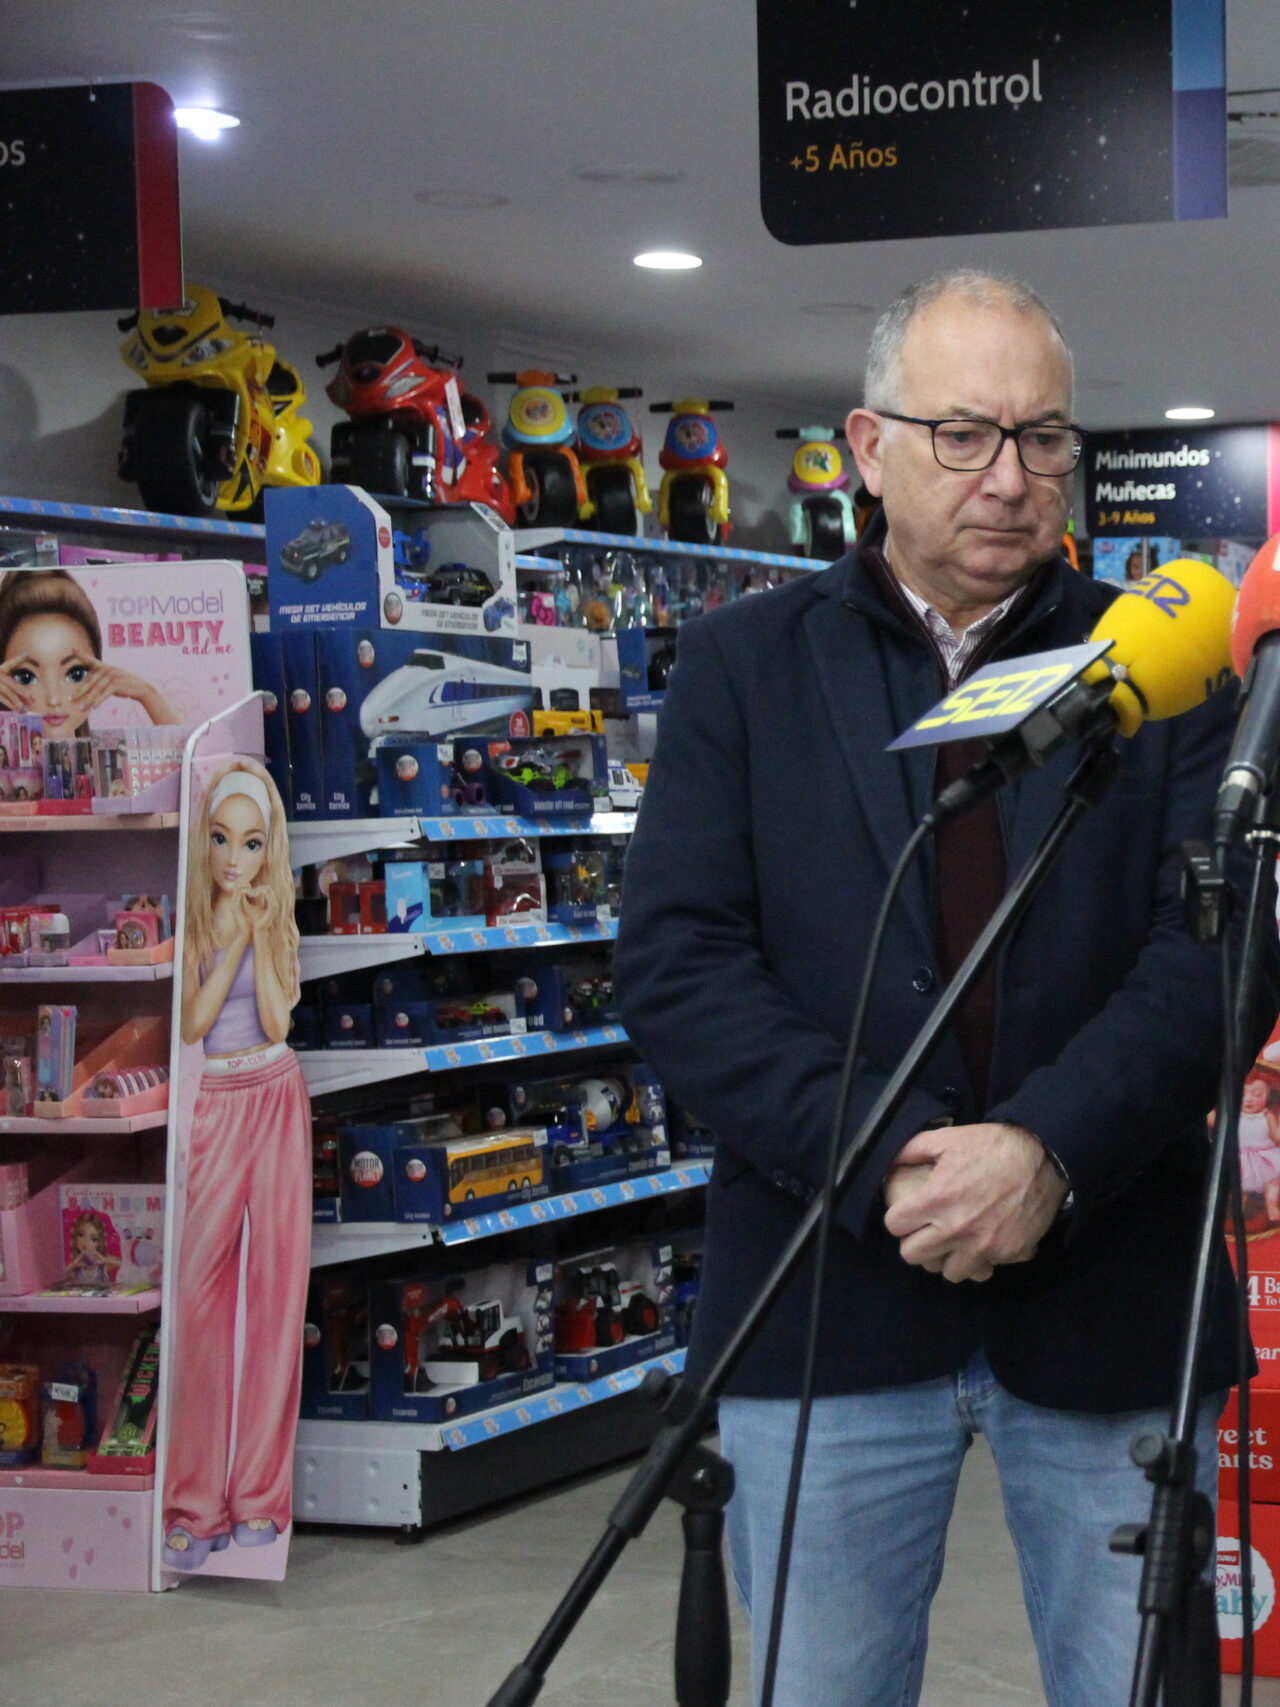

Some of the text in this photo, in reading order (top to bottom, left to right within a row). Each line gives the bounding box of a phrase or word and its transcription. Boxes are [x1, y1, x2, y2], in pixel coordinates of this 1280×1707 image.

[785, 58, 1043, 121] Radiocontrol
[790, 141, 898, 172] +5 Años
[1095, 444, 1211, 471] Minimundos
[1095, 480, 1177, 503] Muñecas
[1123, 509, 1156, 525] Años
[106, 590, 225, 616] TOPModel
[107, 620, 224, 648] BEAUTY
[182, 637, 210, 655] and
[914, 662, 1074, 731] SER
[353, 1157, 380, 1169] MOTOR
[1264, 1295, 1278, 1306] To
